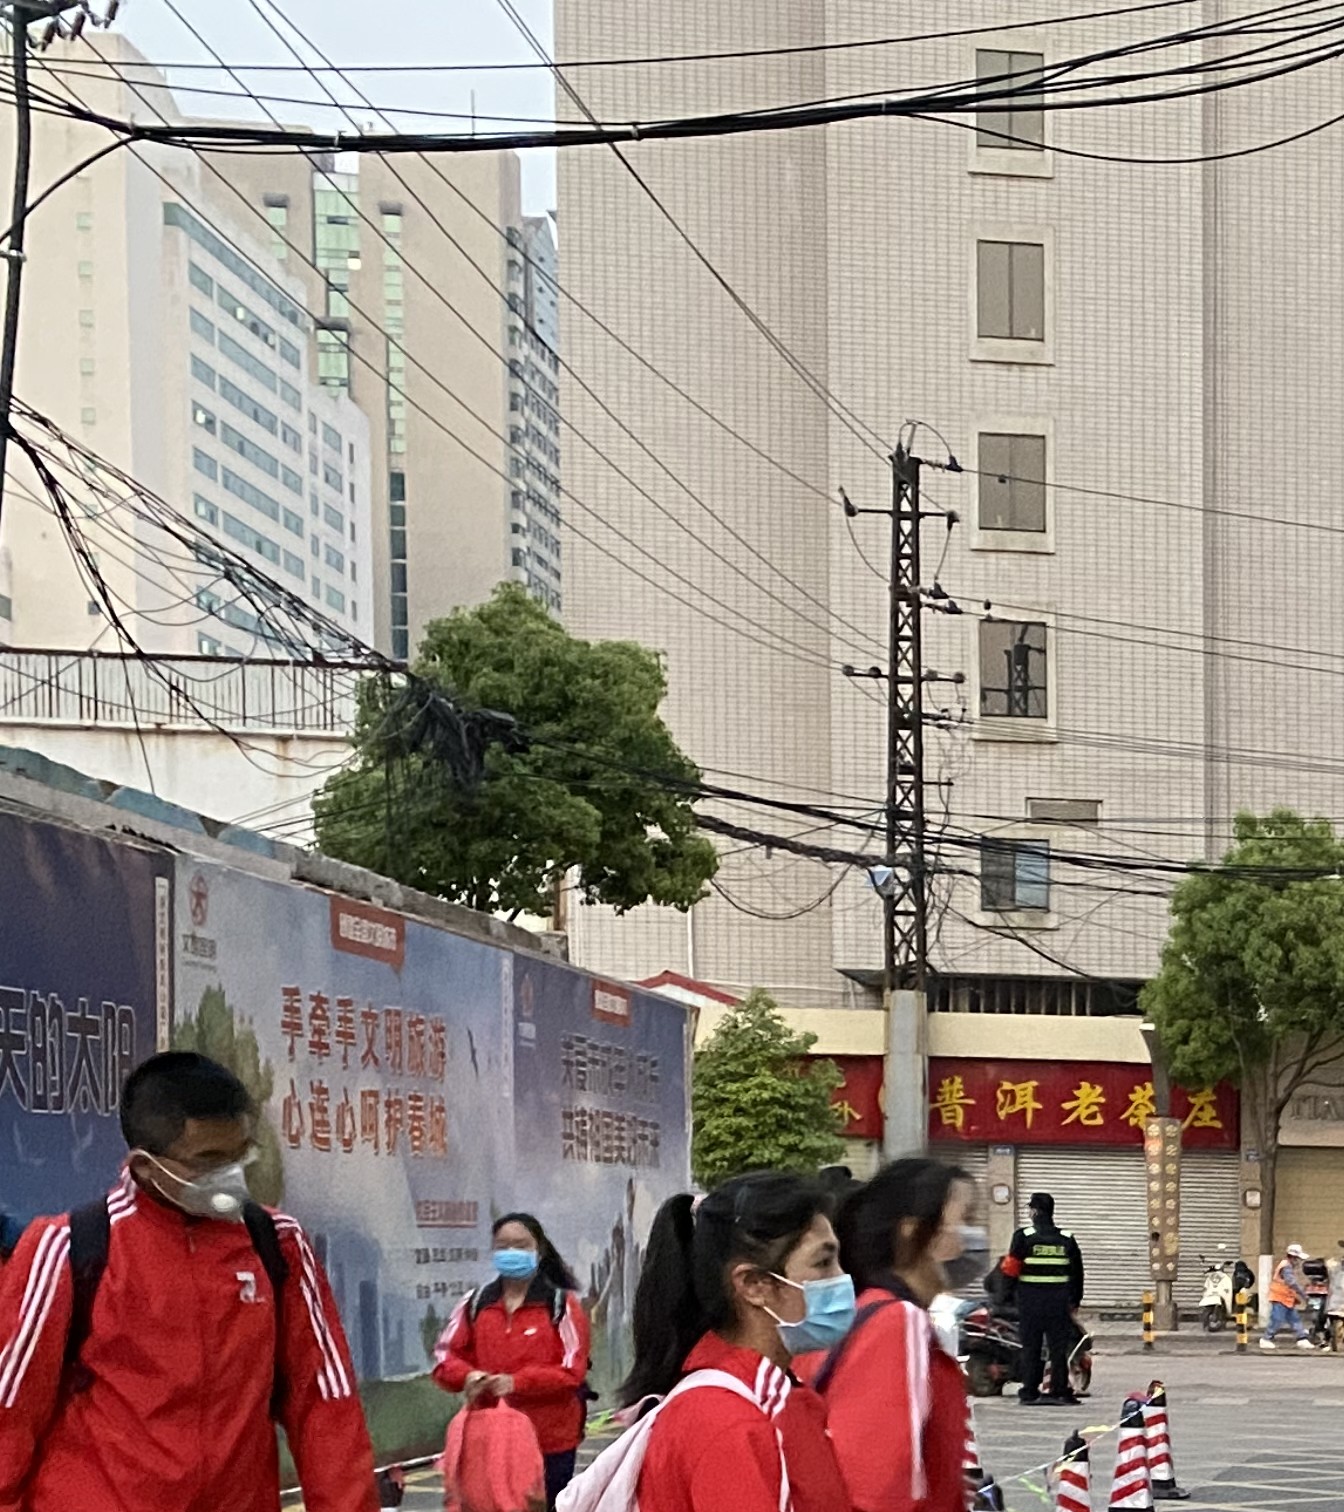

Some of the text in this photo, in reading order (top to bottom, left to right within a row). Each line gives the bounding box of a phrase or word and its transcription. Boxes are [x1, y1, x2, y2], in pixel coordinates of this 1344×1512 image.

[280, 986, 447, 1083] 手牵手文明旅游
[282, 1078, 448, 1160] 心连心呵护春城
[930, 1074, 1223, 1134] 普洱老茶庄
